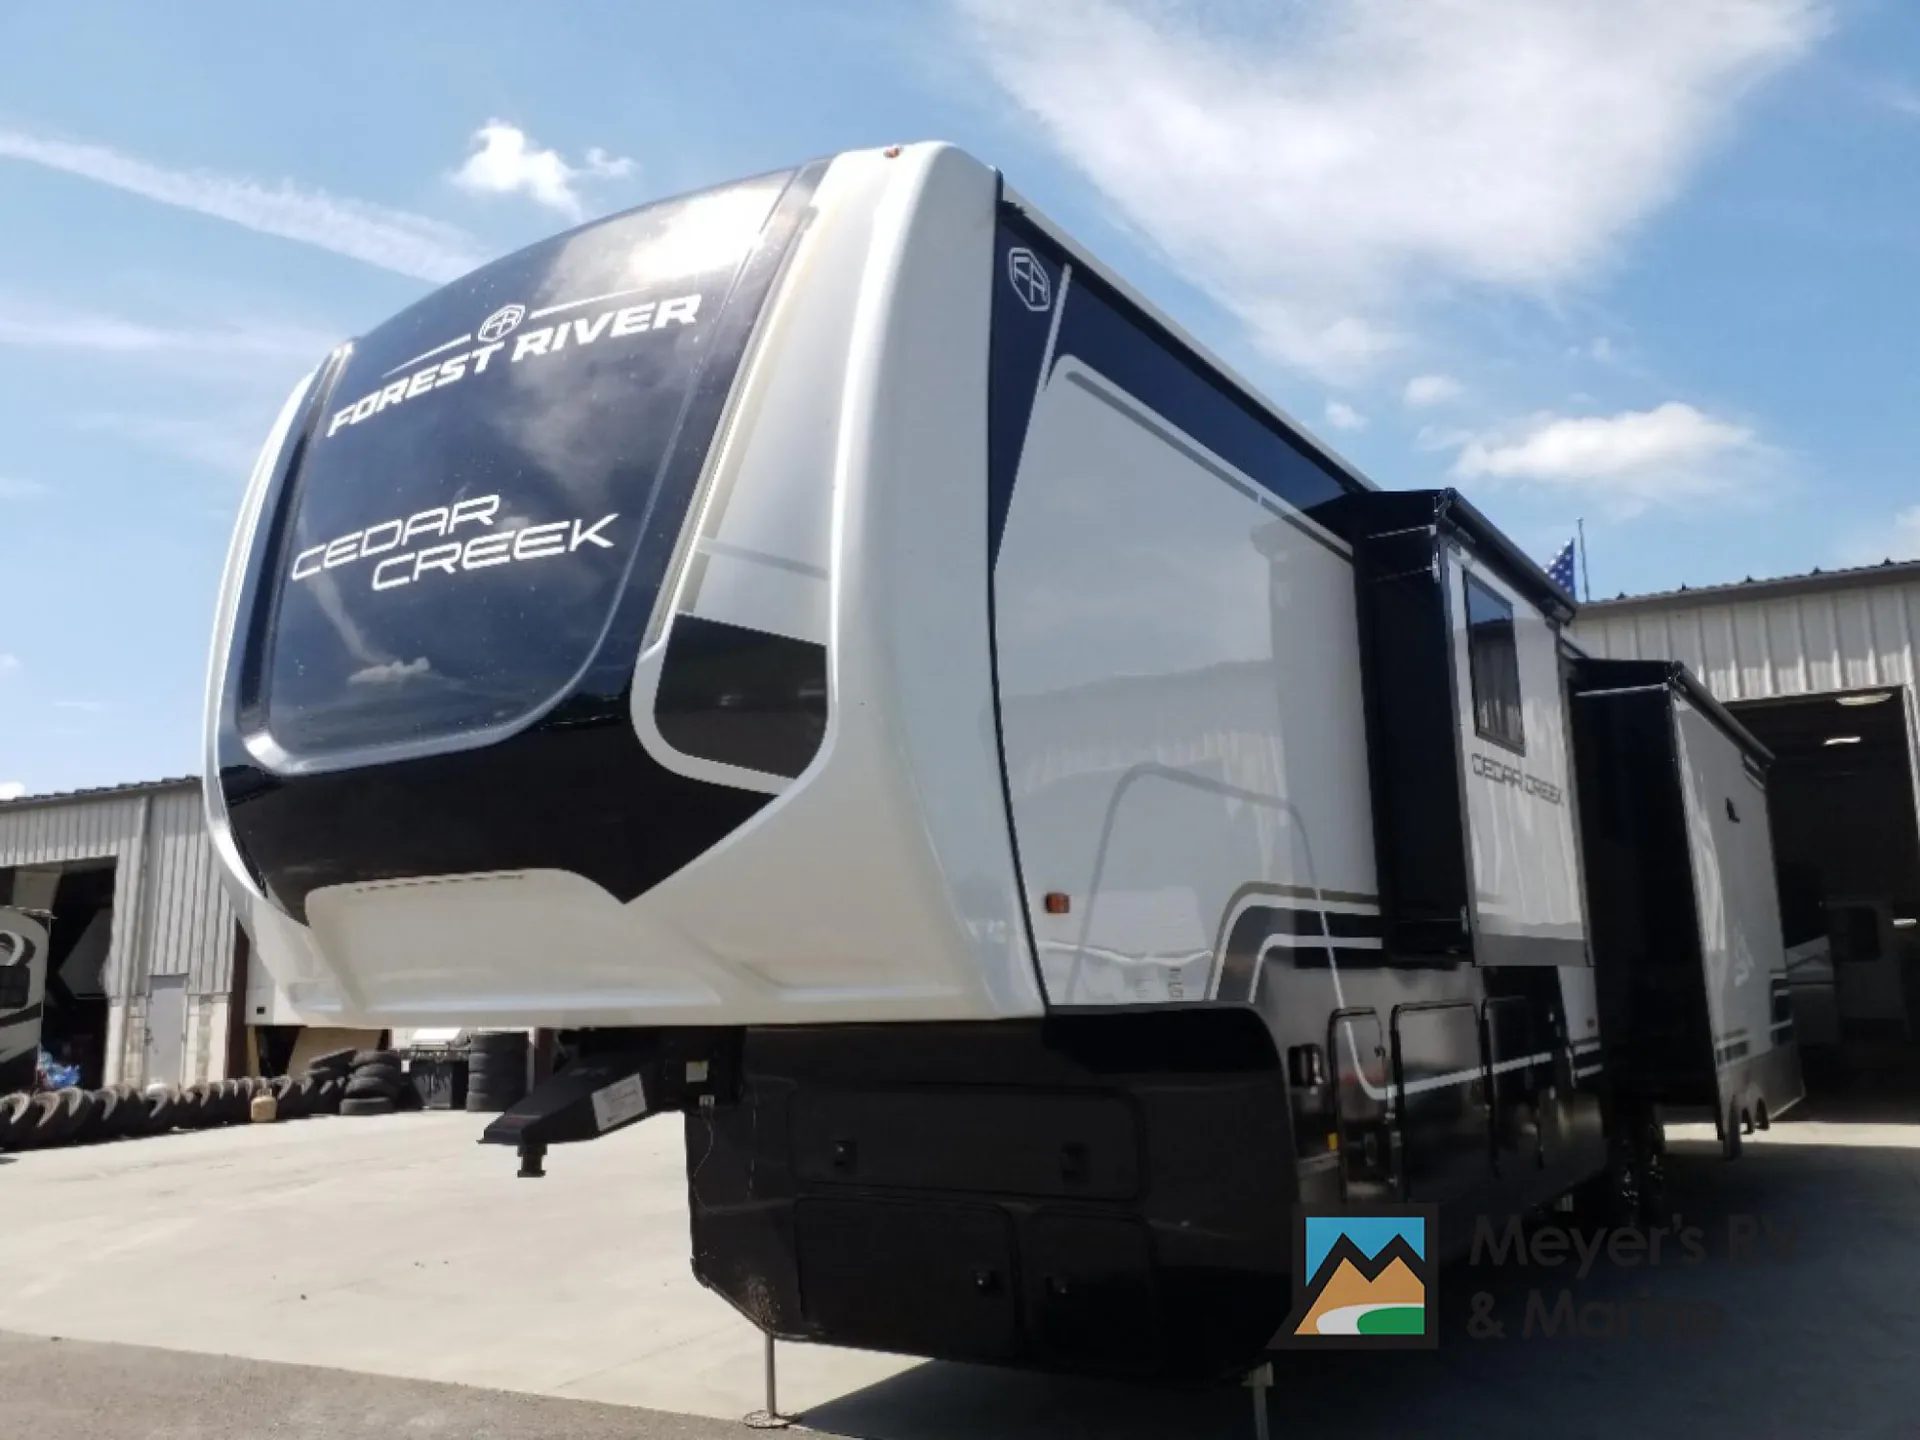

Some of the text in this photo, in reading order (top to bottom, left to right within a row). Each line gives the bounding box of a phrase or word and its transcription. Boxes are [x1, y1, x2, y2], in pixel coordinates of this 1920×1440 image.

[327, 295, 701, 437] FOREST RIVER
[292, 495, 499, 581] CEDAR
[372, 513, 619, 591] CREEK
[1472, 753, 1523, 790] CEDAR
